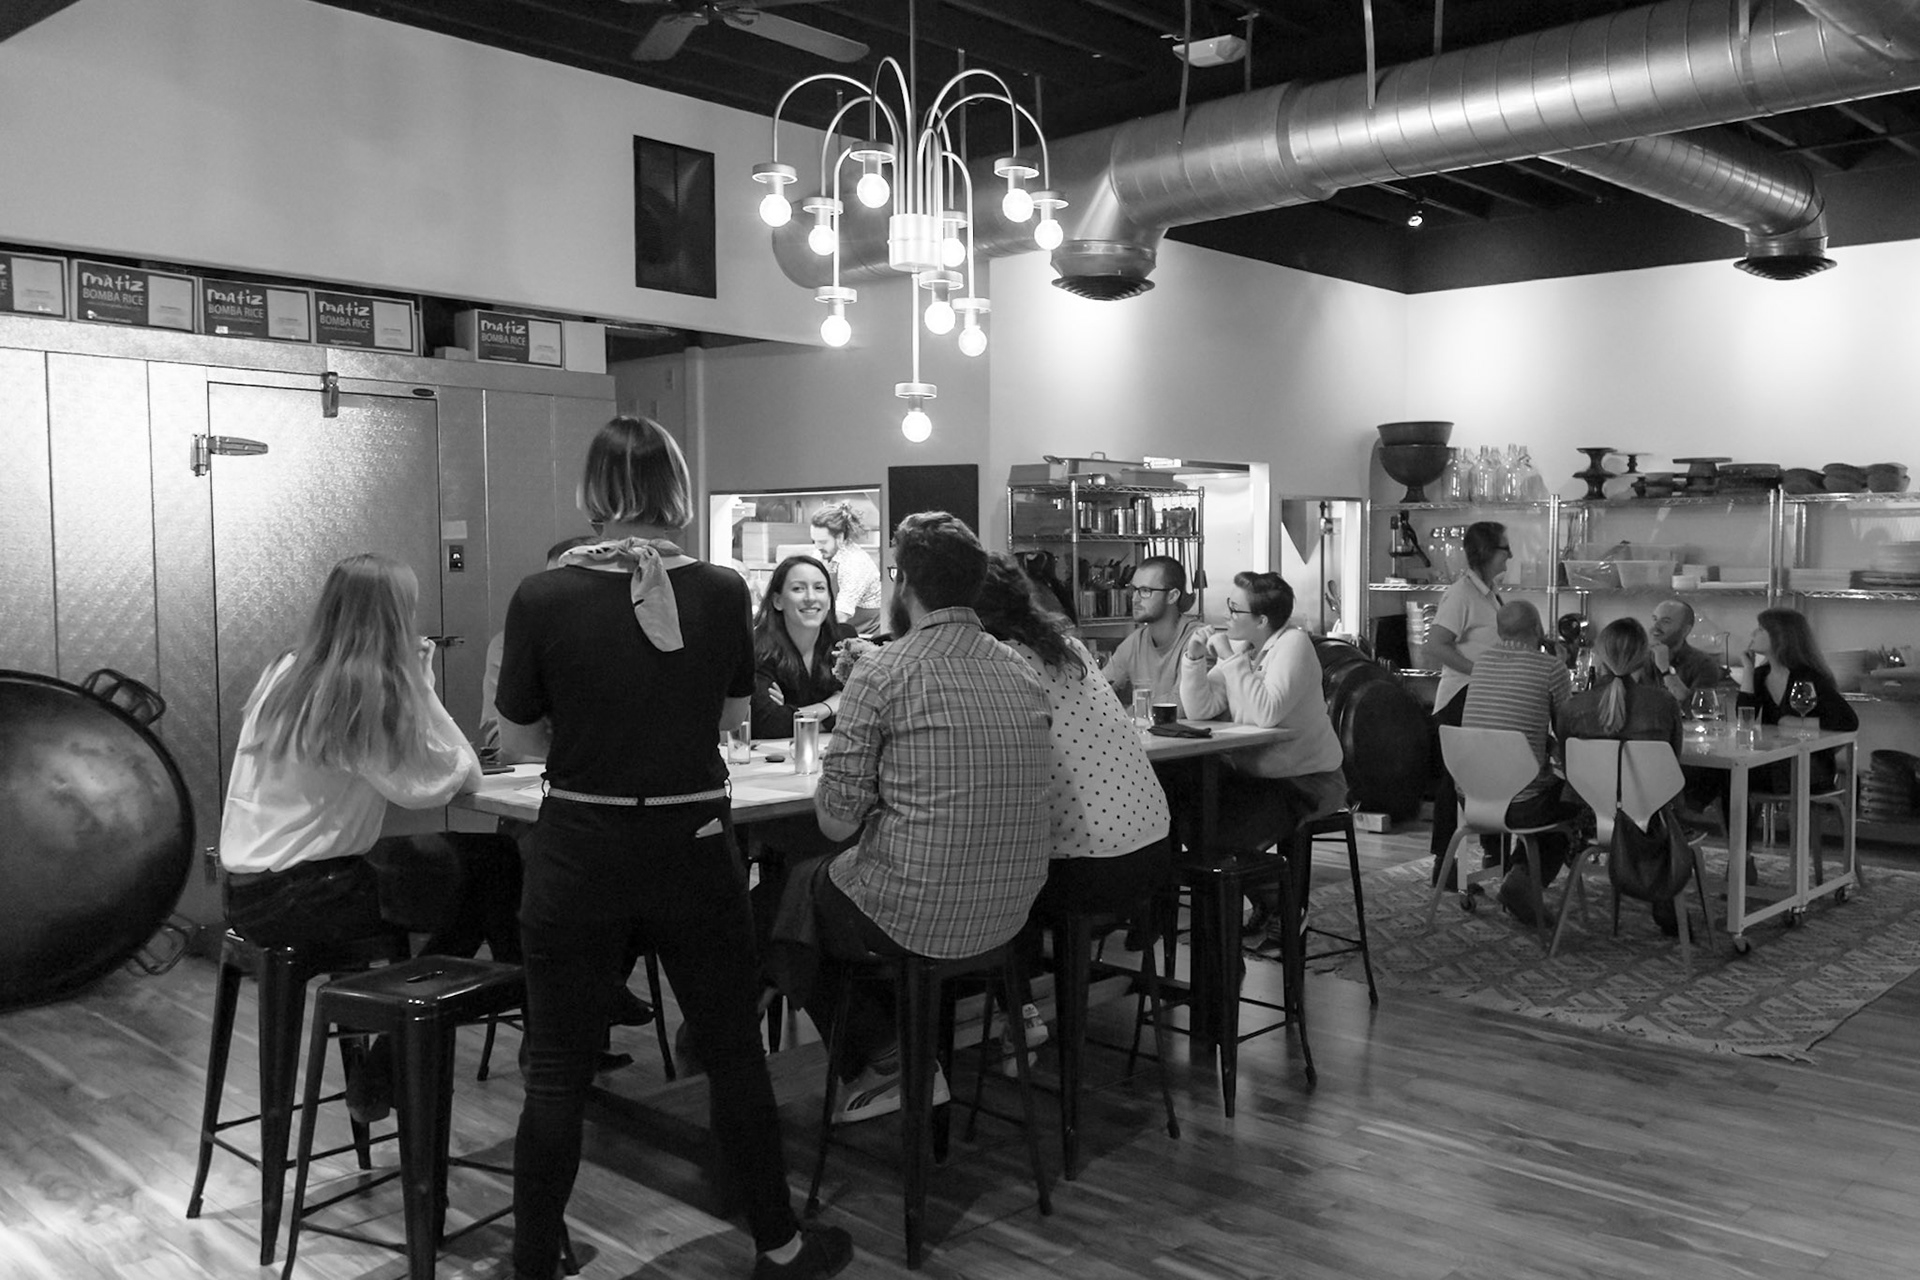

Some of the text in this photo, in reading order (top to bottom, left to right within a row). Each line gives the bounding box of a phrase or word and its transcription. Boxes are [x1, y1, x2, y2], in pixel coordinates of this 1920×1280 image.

[82, 287, 120, 302] BOMBA
[122, 293, 144, 306] RICE
[208, 303, 264, 319] BOMBA RICE
[320, 314, 371, 329] BOMBA RICE
[481, 332, 526, 346] BOMBA RICE
